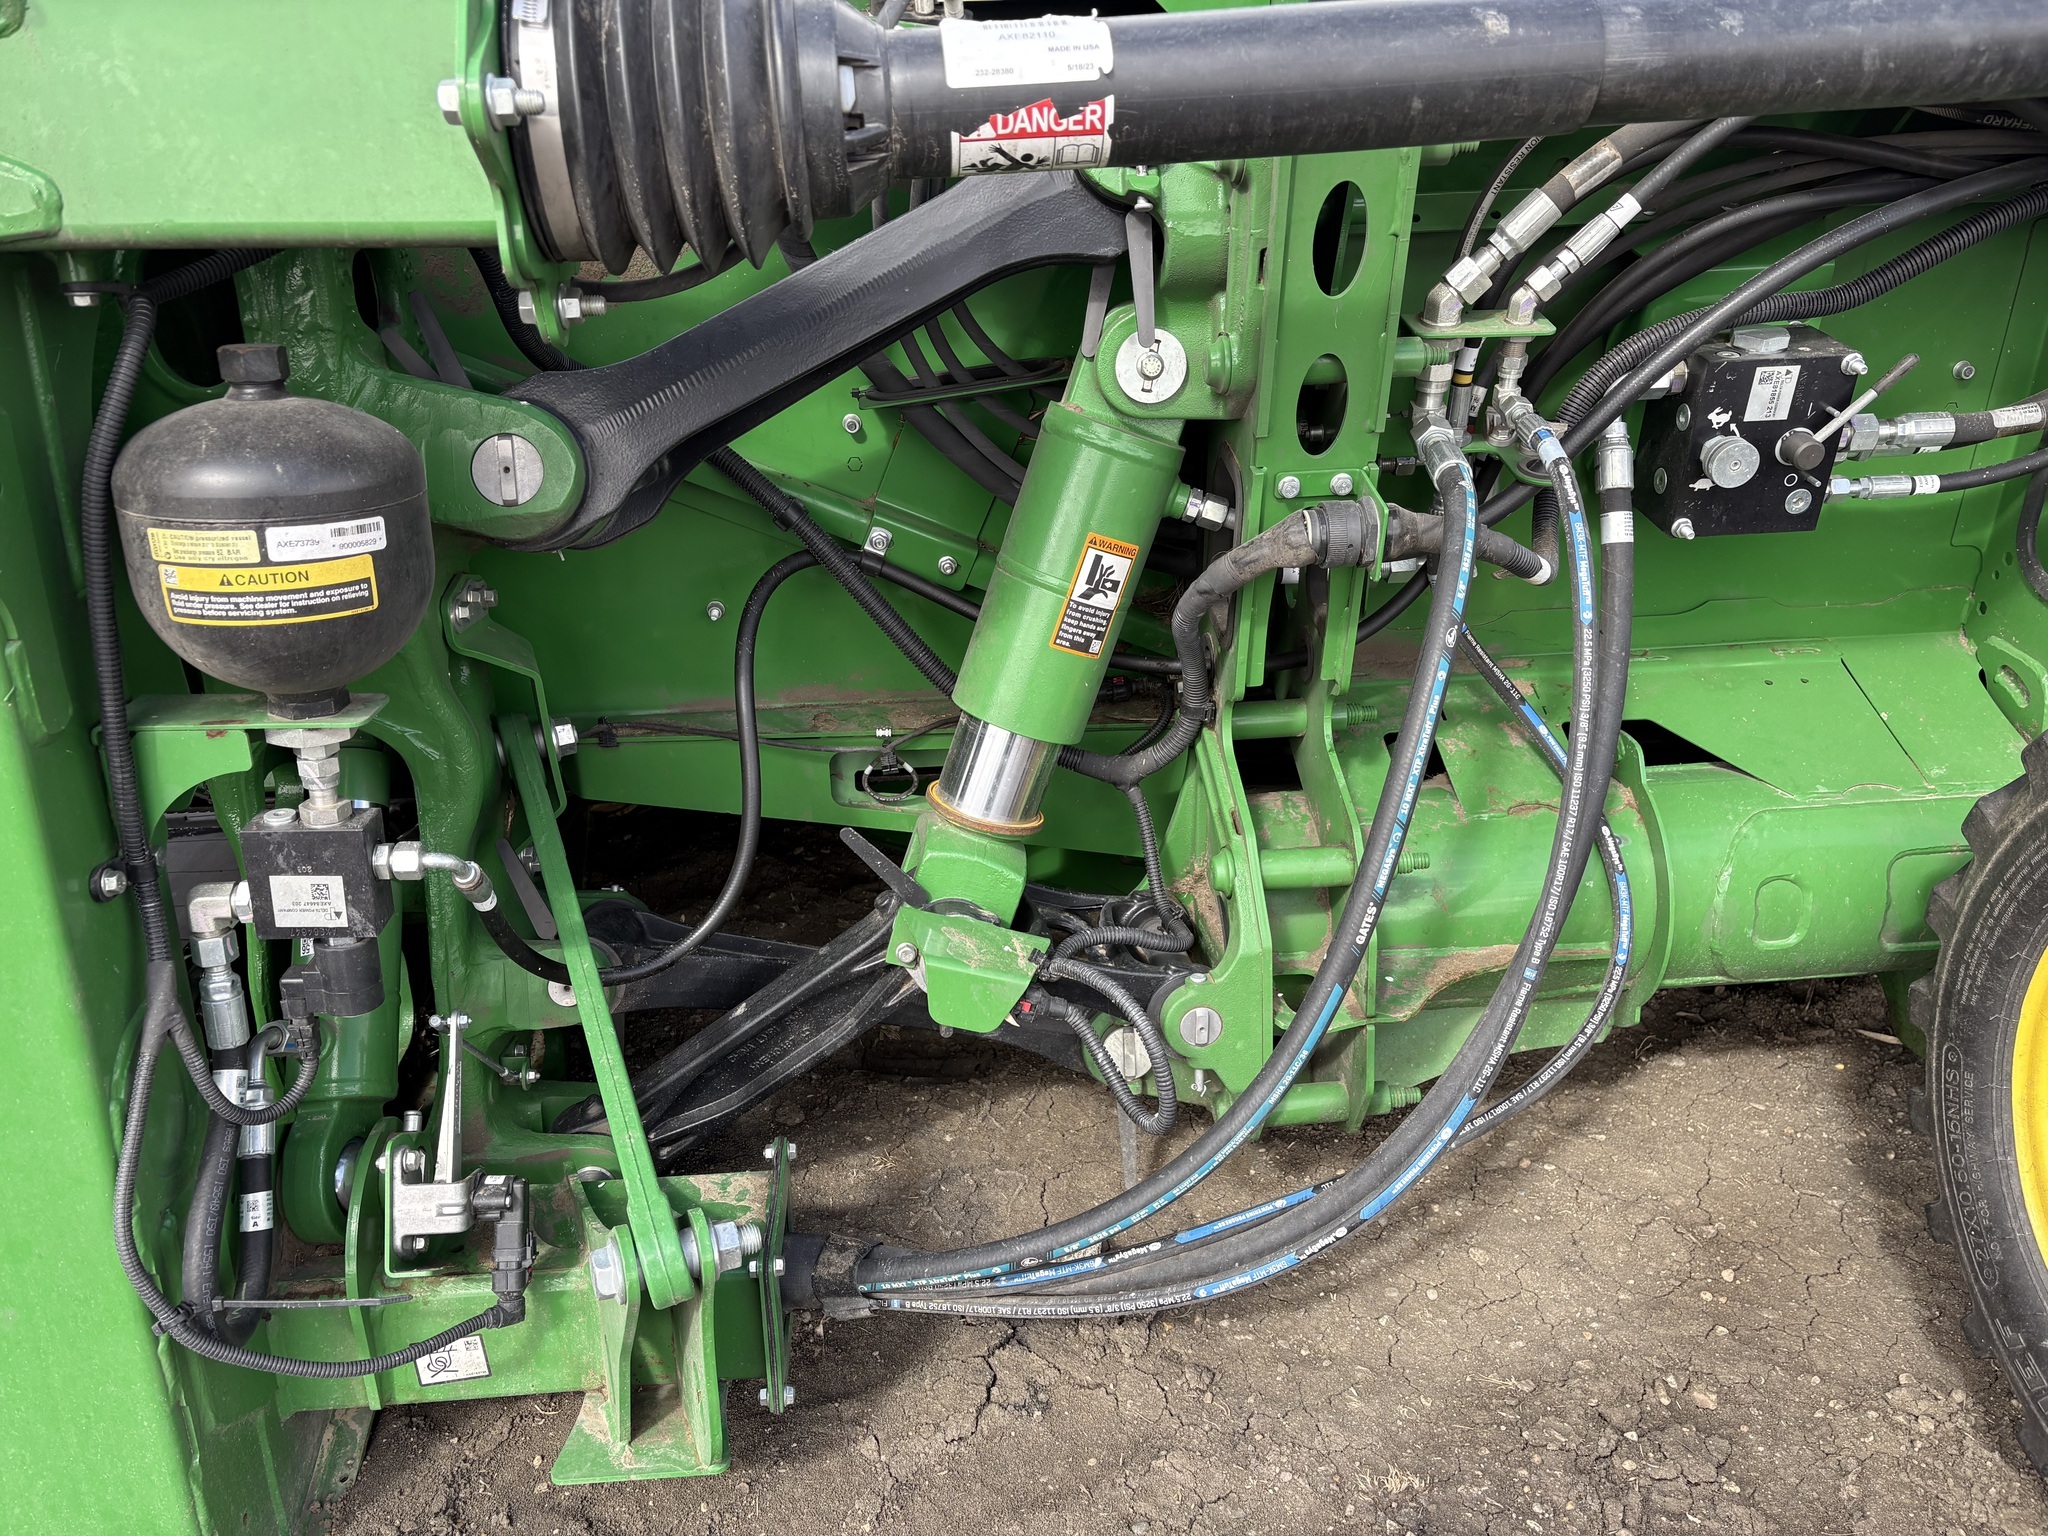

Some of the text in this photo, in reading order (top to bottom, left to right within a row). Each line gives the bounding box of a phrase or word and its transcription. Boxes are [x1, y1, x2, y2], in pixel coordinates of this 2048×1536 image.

[998, 31, 1056, 40] AXE82110
[975, 62, 1094, 76] 232-28380 5/18/23
[997, 104, 1102, 134] DANGER
[1490, 151, 1526, 196] RESISTANT
[1769, 370, 1782, 405] AXE81855
[339, 538, 377, 550] 900005829
[1099, 540, 1137, 557] WARNING
[1466, 539, 1474, 552] psi
[236, 570, 310, 586] CAUTION
[171, 592, 188, 600] Avoid
[189, 594, 210, 603] injury
[266, 592, 308, 601] movement
[310, 589, 324, 598] and
[326, 584, 360, 595] exposure
[204, 602, 238, 611] pressure.
[255, 602, 278, 610] dealer
[280, 600, 290, 608] for
[292, 597, 330, 607] instruction
[342, 590, 369, 600] relieving
[174, 607, 298, 617] pressure before servicing system.
[1066, 608, 1108, 626] from crushing,
[1078, 604, 1096, 614] avoid
[1096, 610, 1110, 618] injury
[1061, 624, 1096, 638] fingers away
[1064, 616, 1078, 626] keep
[1080, 620, 1096, 631] hands
[1056, 639, 1070, 648] area.
[1058, 630, 1085, 644] from this
[1584, 628, 1592, 647] 22.5
[1464, 630, 1477, 646] Flame
[1474, 644, 1494, 669] Resistant
[1492, 665, 1506, 682] MSHA
[1584, 648, 1592, 666] MPa
[1400, 803, 1409, 816] 10
[1411, 757, 1423, 776] XTP
[1428, 694, 1440, 708] Plus
[1572, 773, 1583, 788] ISO
[1569, 789, 1581, 818] 11237
[1566, 818, 1576, 834] R17
[1561, 842, 1572, 859] SAE
[1548, 897, 1560, 911] ISO
[1540, 910, 1556, 937] 18752
[1534, 938, 1548, 956] Type
[1532, 956, 1541, 964] B
[1613, 966, 1624, 980] 22.5
[1607, 979, 1620, 994] MPa
[1516, 982, 1532, 1008] Flame
[1499, 1006, 1522, 1048] Resistant
[1488, 1044, 1506, 1065] MSHA
[1555, 1056, 1567, 1069] ISO
[1539, 1063, 1558, 1085] 11237
[1528, 1078, 1540, 1093] R17
[1268, 1084, 1286, 1106] MSHA
[1510, 1091, 1526, 1104] SAE
[1963, 1072, 1975, 1125] SERVICE
[1472, 1113, 1488, 1128] ISO
[202, 1157, 230, 1276] ISO 15540/ISO 15541
[1110, 1224, 1122, 1235] psi
[964, 1272, 982, 1280] Plus
[1254, 1260, 1288, 1282] 6M3K-MTF
[904, 1300, 910, 1308] B
[912, 1300, 928, 1310] Type
[928, 1302, 952, 1312] 18752
[953, 1304, 965, 1312] ISO
[1158, 1296, 1176, 1306] MPa
[998, 1306, 1012, 1315] SAE
[1018, 1307, 1032, 1316] R17
[1034, 1307, 1056, 1316] 11237
[1056, 1307, 1070, 1315] ISO
